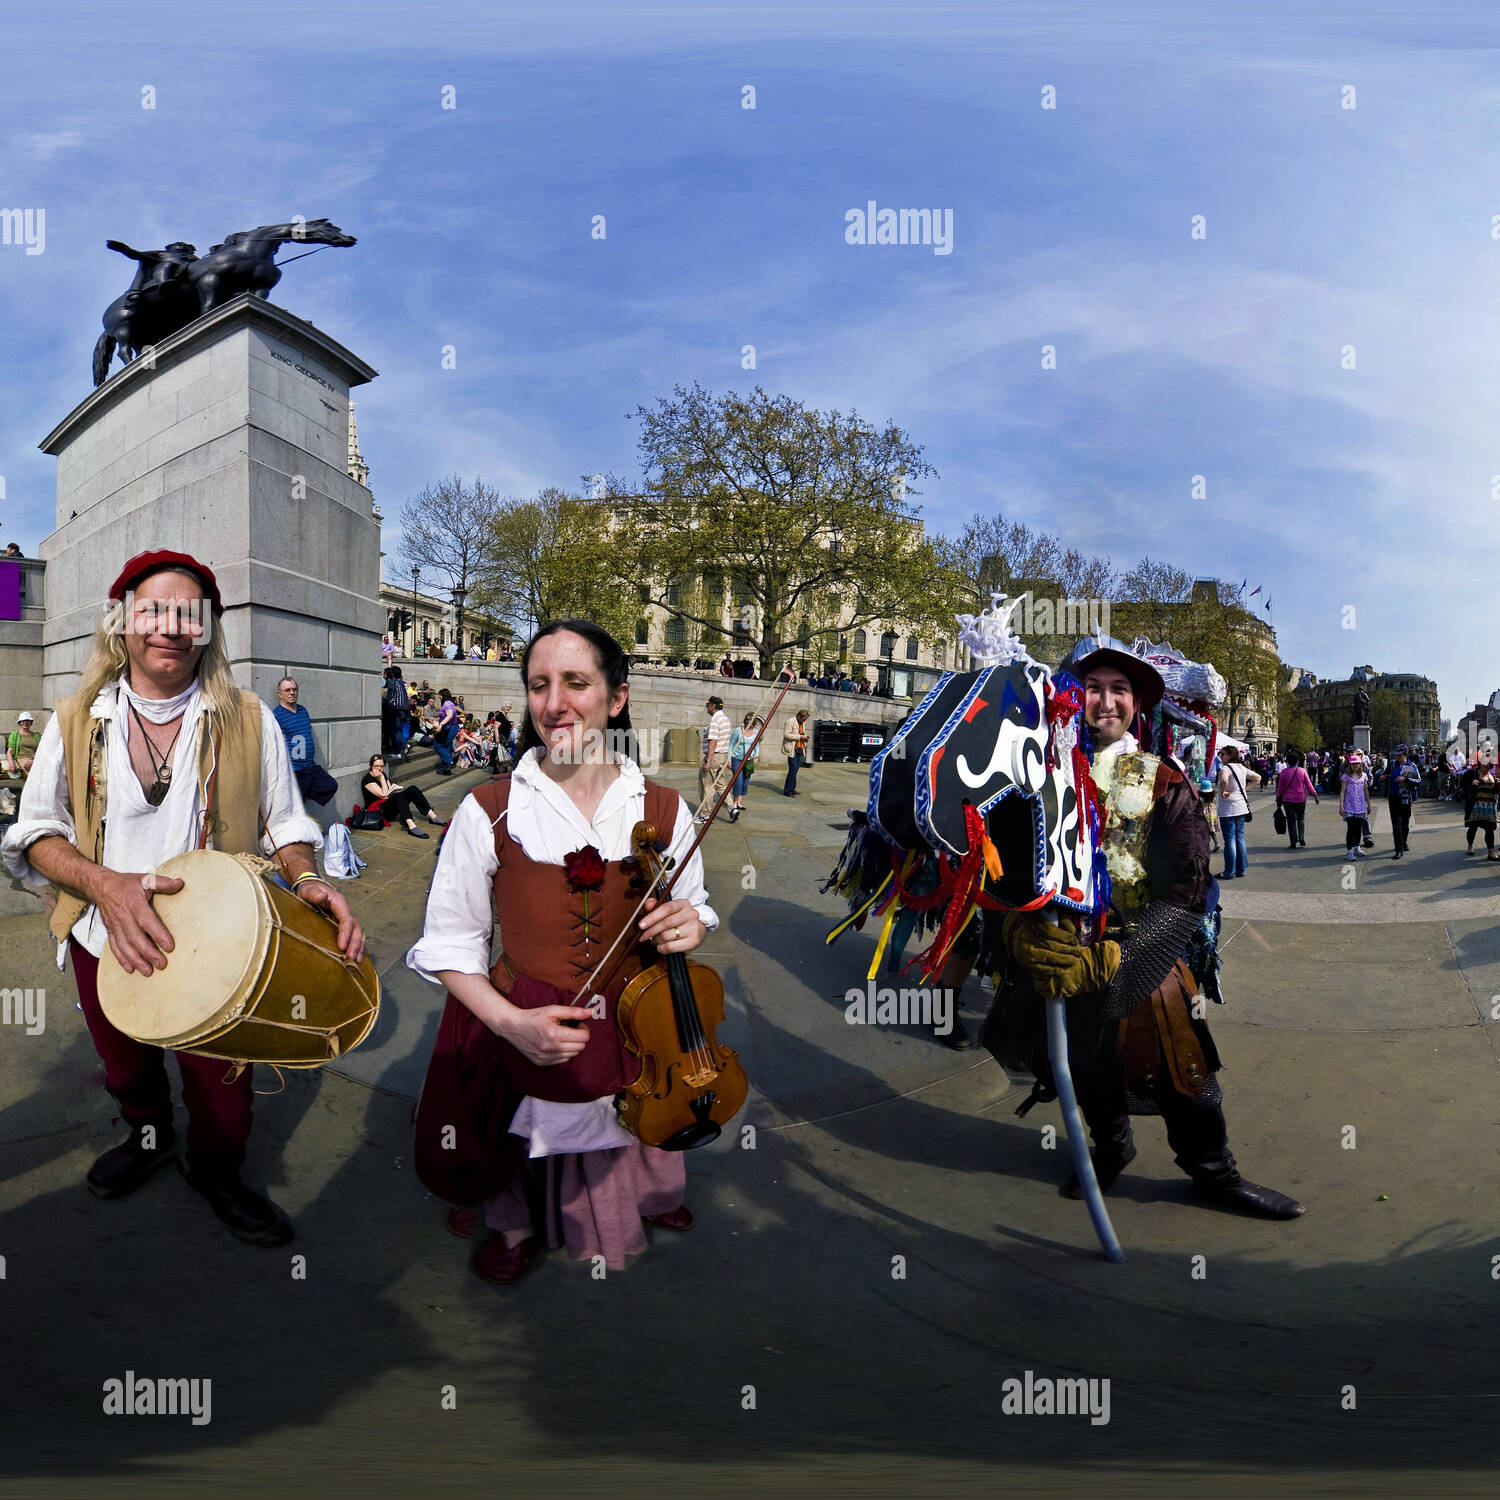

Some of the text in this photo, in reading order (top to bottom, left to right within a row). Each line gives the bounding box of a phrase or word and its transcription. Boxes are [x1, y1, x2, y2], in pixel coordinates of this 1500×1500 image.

[270, 350, 335, 392] KING GEORGE IV
